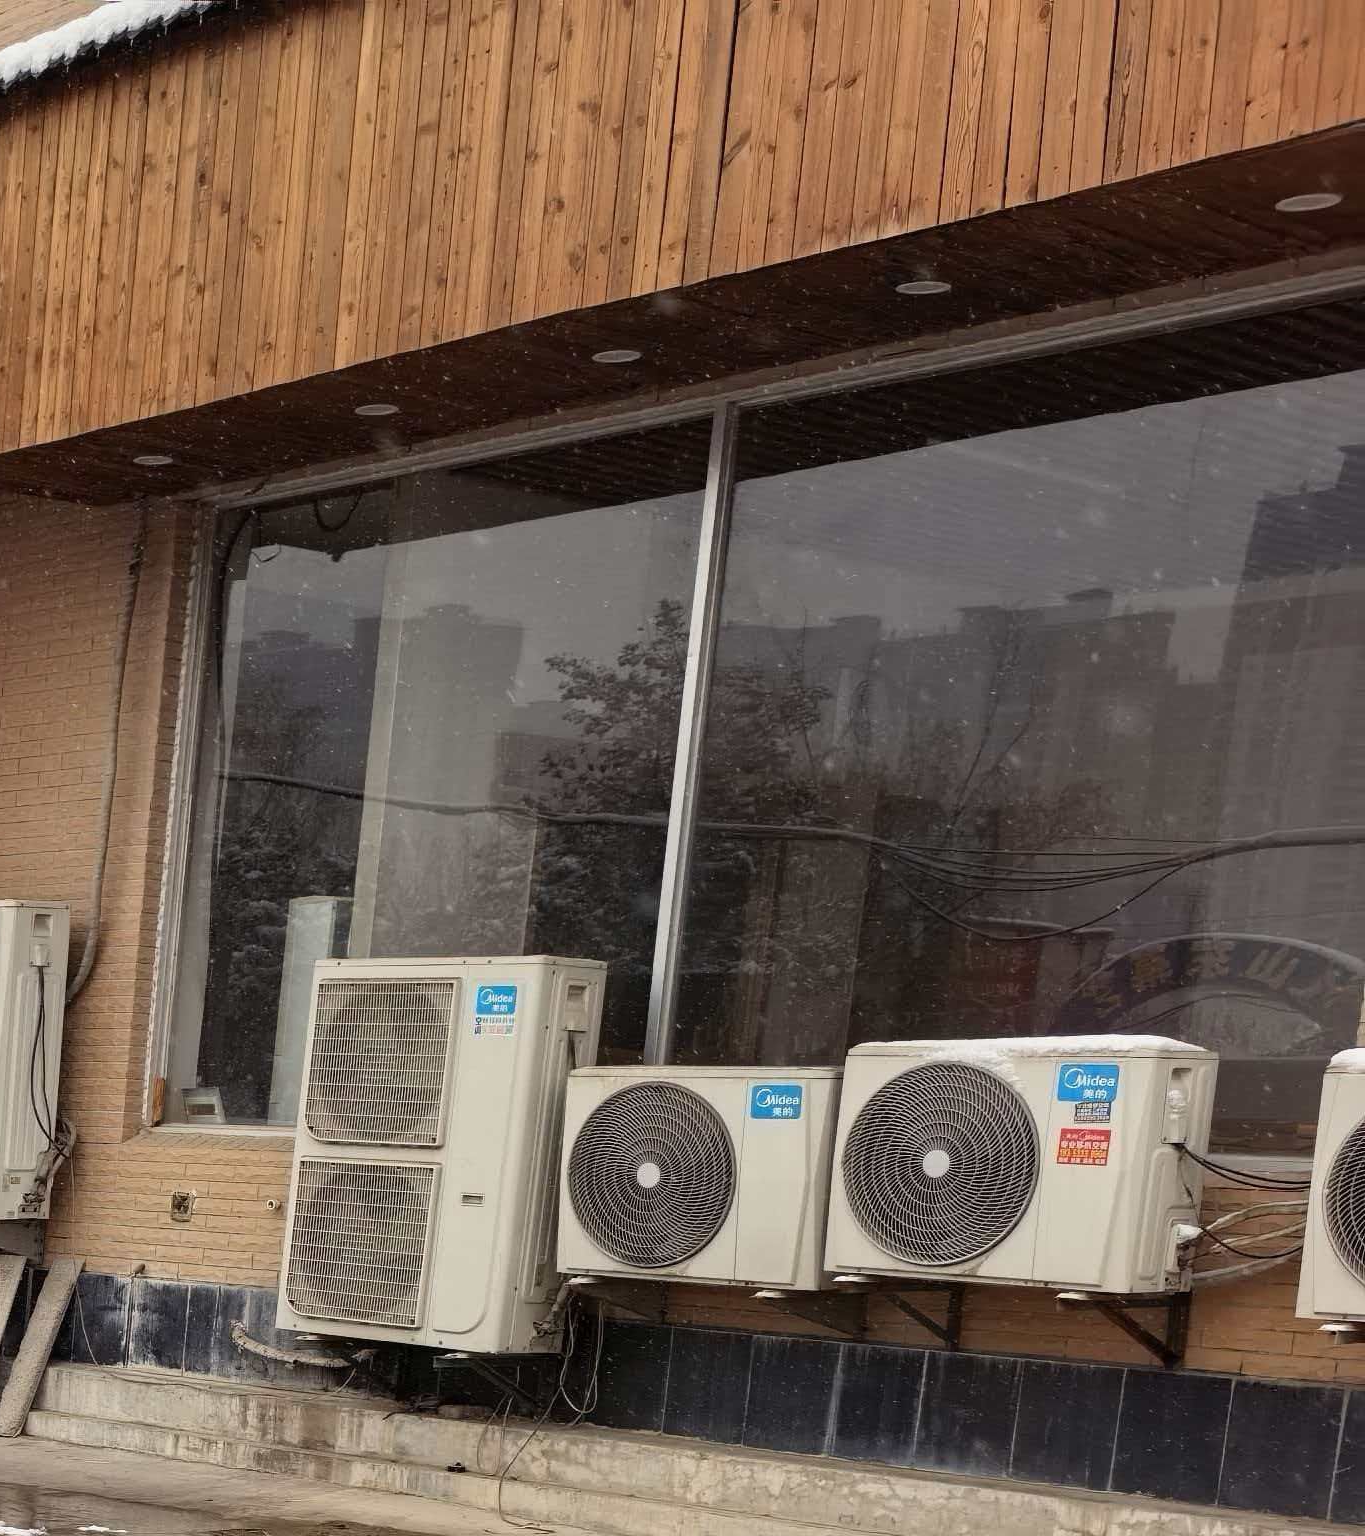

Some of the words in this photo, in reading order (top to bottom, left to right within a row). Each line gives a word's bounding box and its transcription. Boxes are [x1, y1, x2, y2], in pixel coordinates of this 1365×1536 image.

[479, 988, 514, 1005] Midea
[1064, 1067, 1116, 1089] Midea
[755, 1088, 799, 1108] Midea
[1083, 1088, 1108, 1099] 美的
